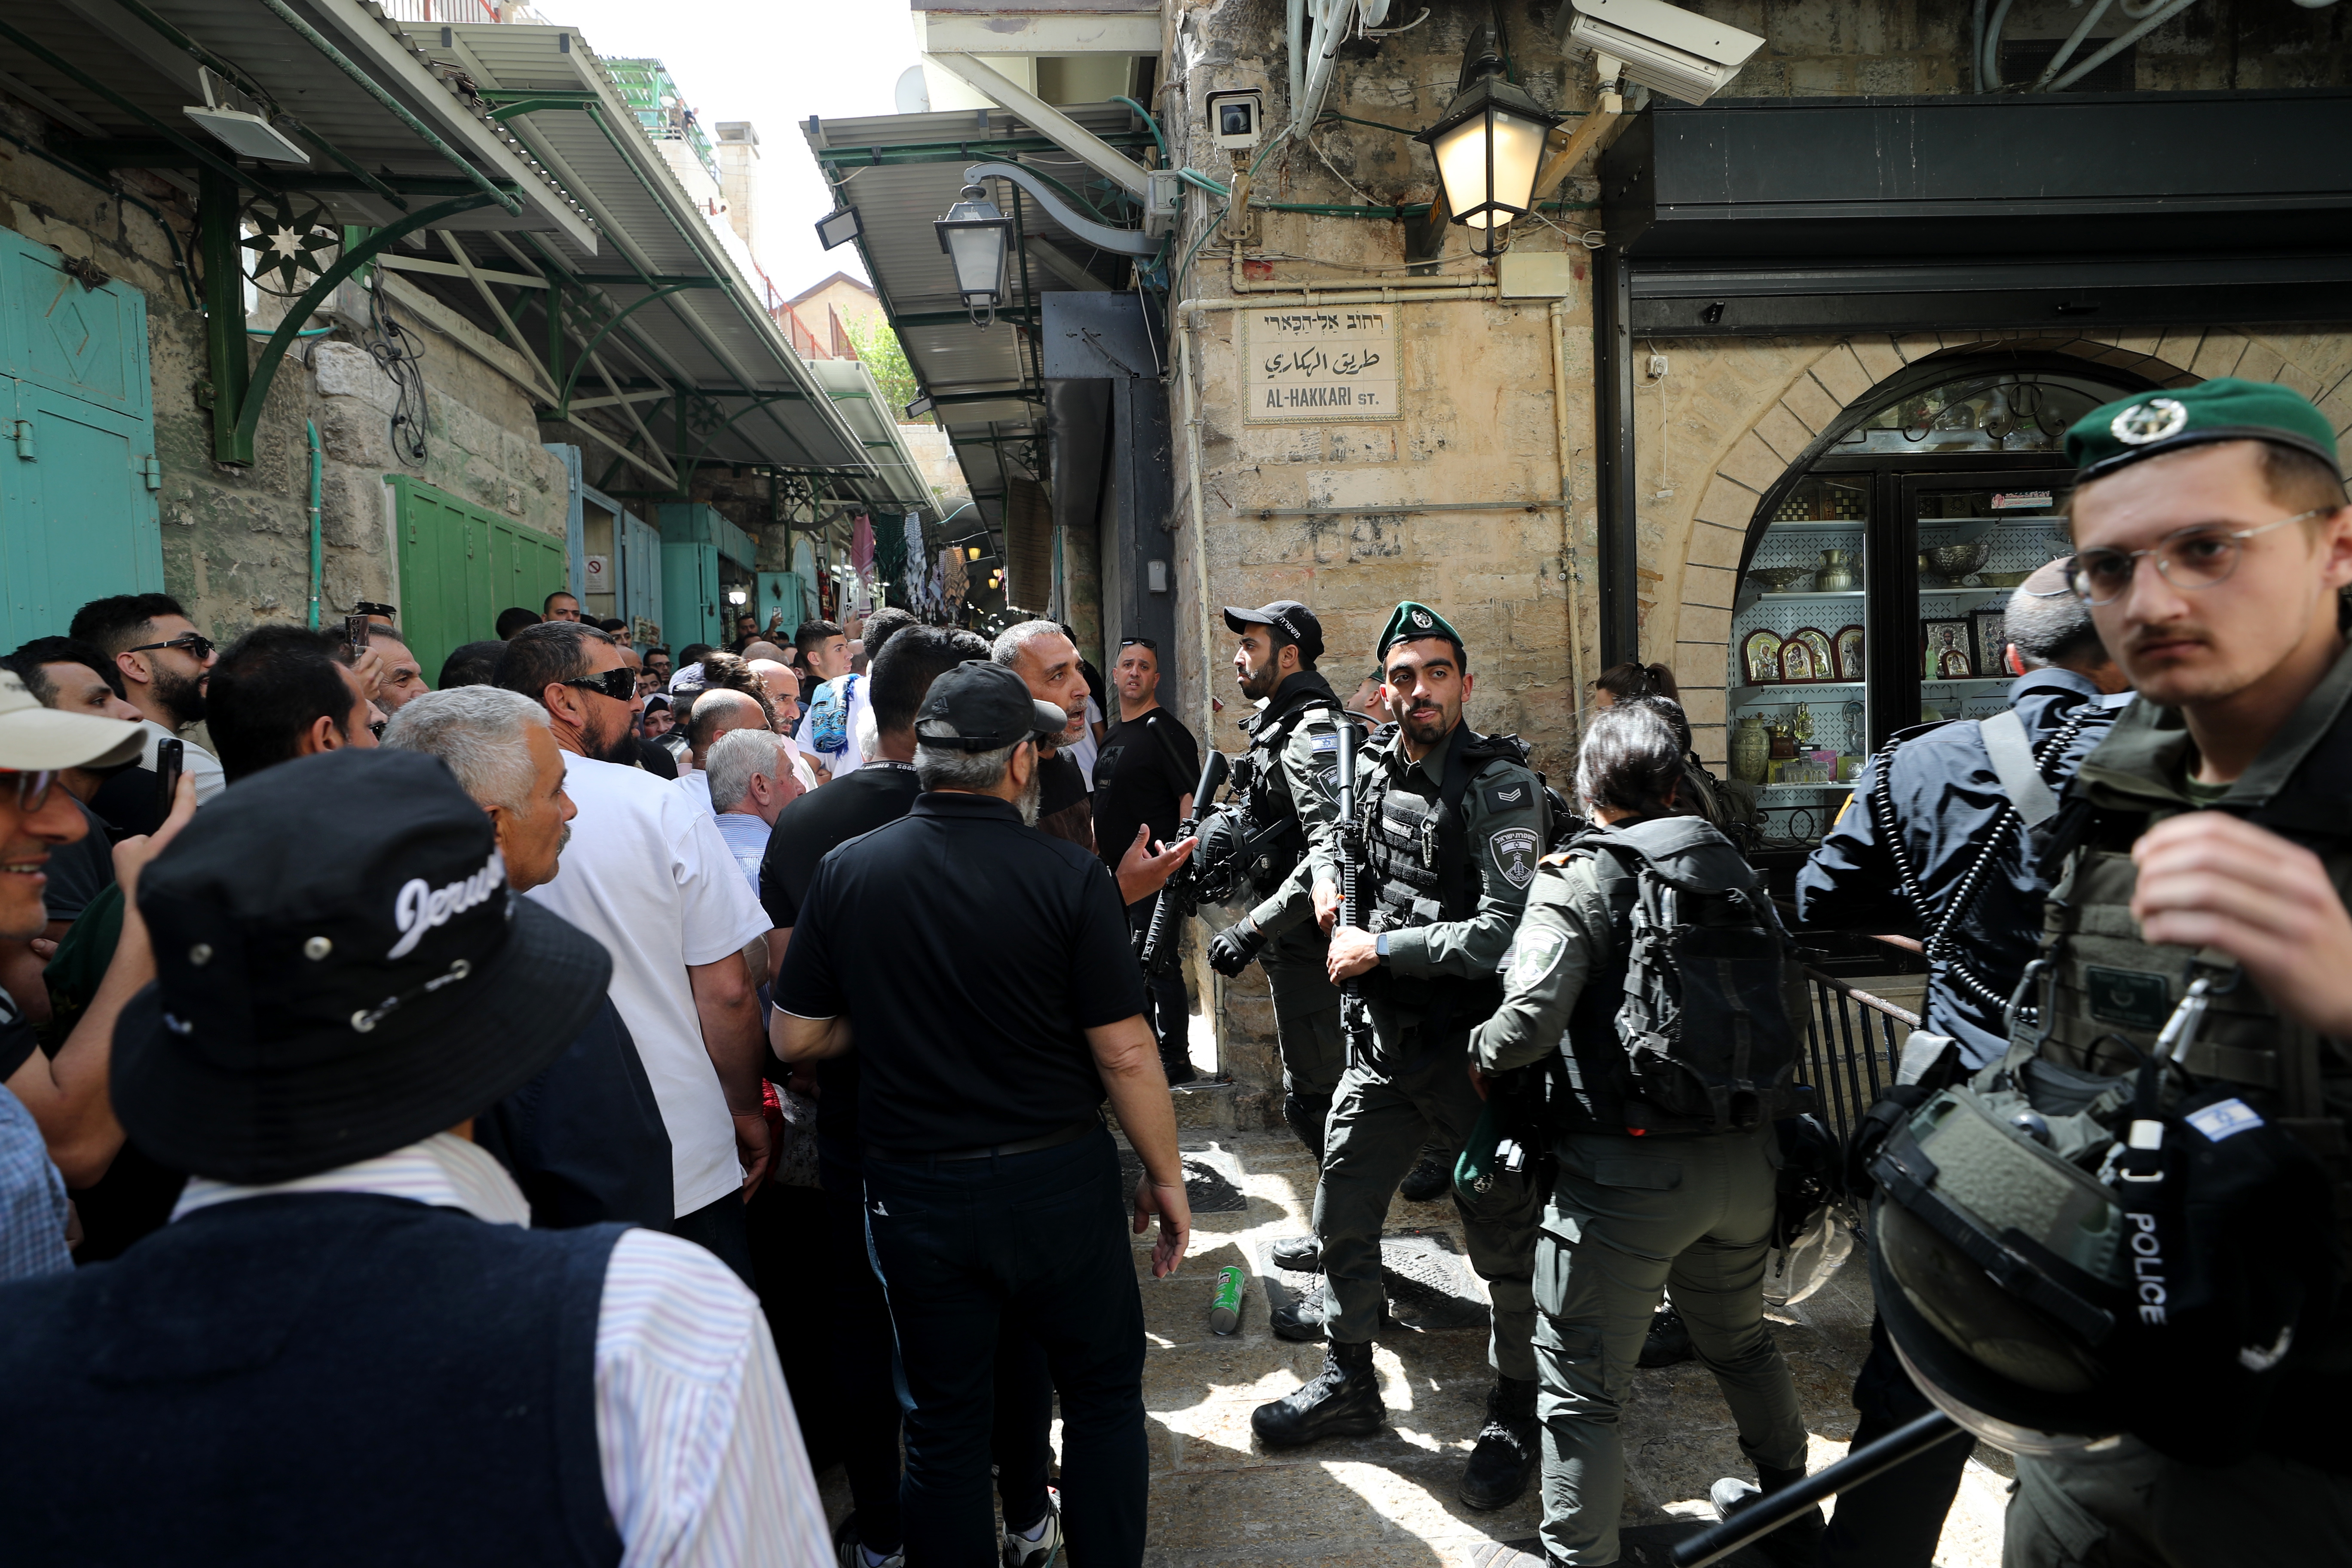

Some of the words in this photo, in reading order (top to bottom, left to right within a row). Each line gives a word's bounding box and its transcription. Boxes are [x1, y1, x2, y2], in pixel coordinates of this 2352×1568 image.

[1265, 346, 1328, 379] الهكاري
[1332, 349, 1380, 375] طريق
[1266, 387, 1351, 408] AL-HAKKARI
[1358, 393, 1379, 405] ST.
[1279, 617, 1301, 639] משטרה
[1494, 833, 1515, 844] ישראל
[1515, 833, 1536, 842] משטרת
[2124, 1213, 2168, 1326] POLICE
